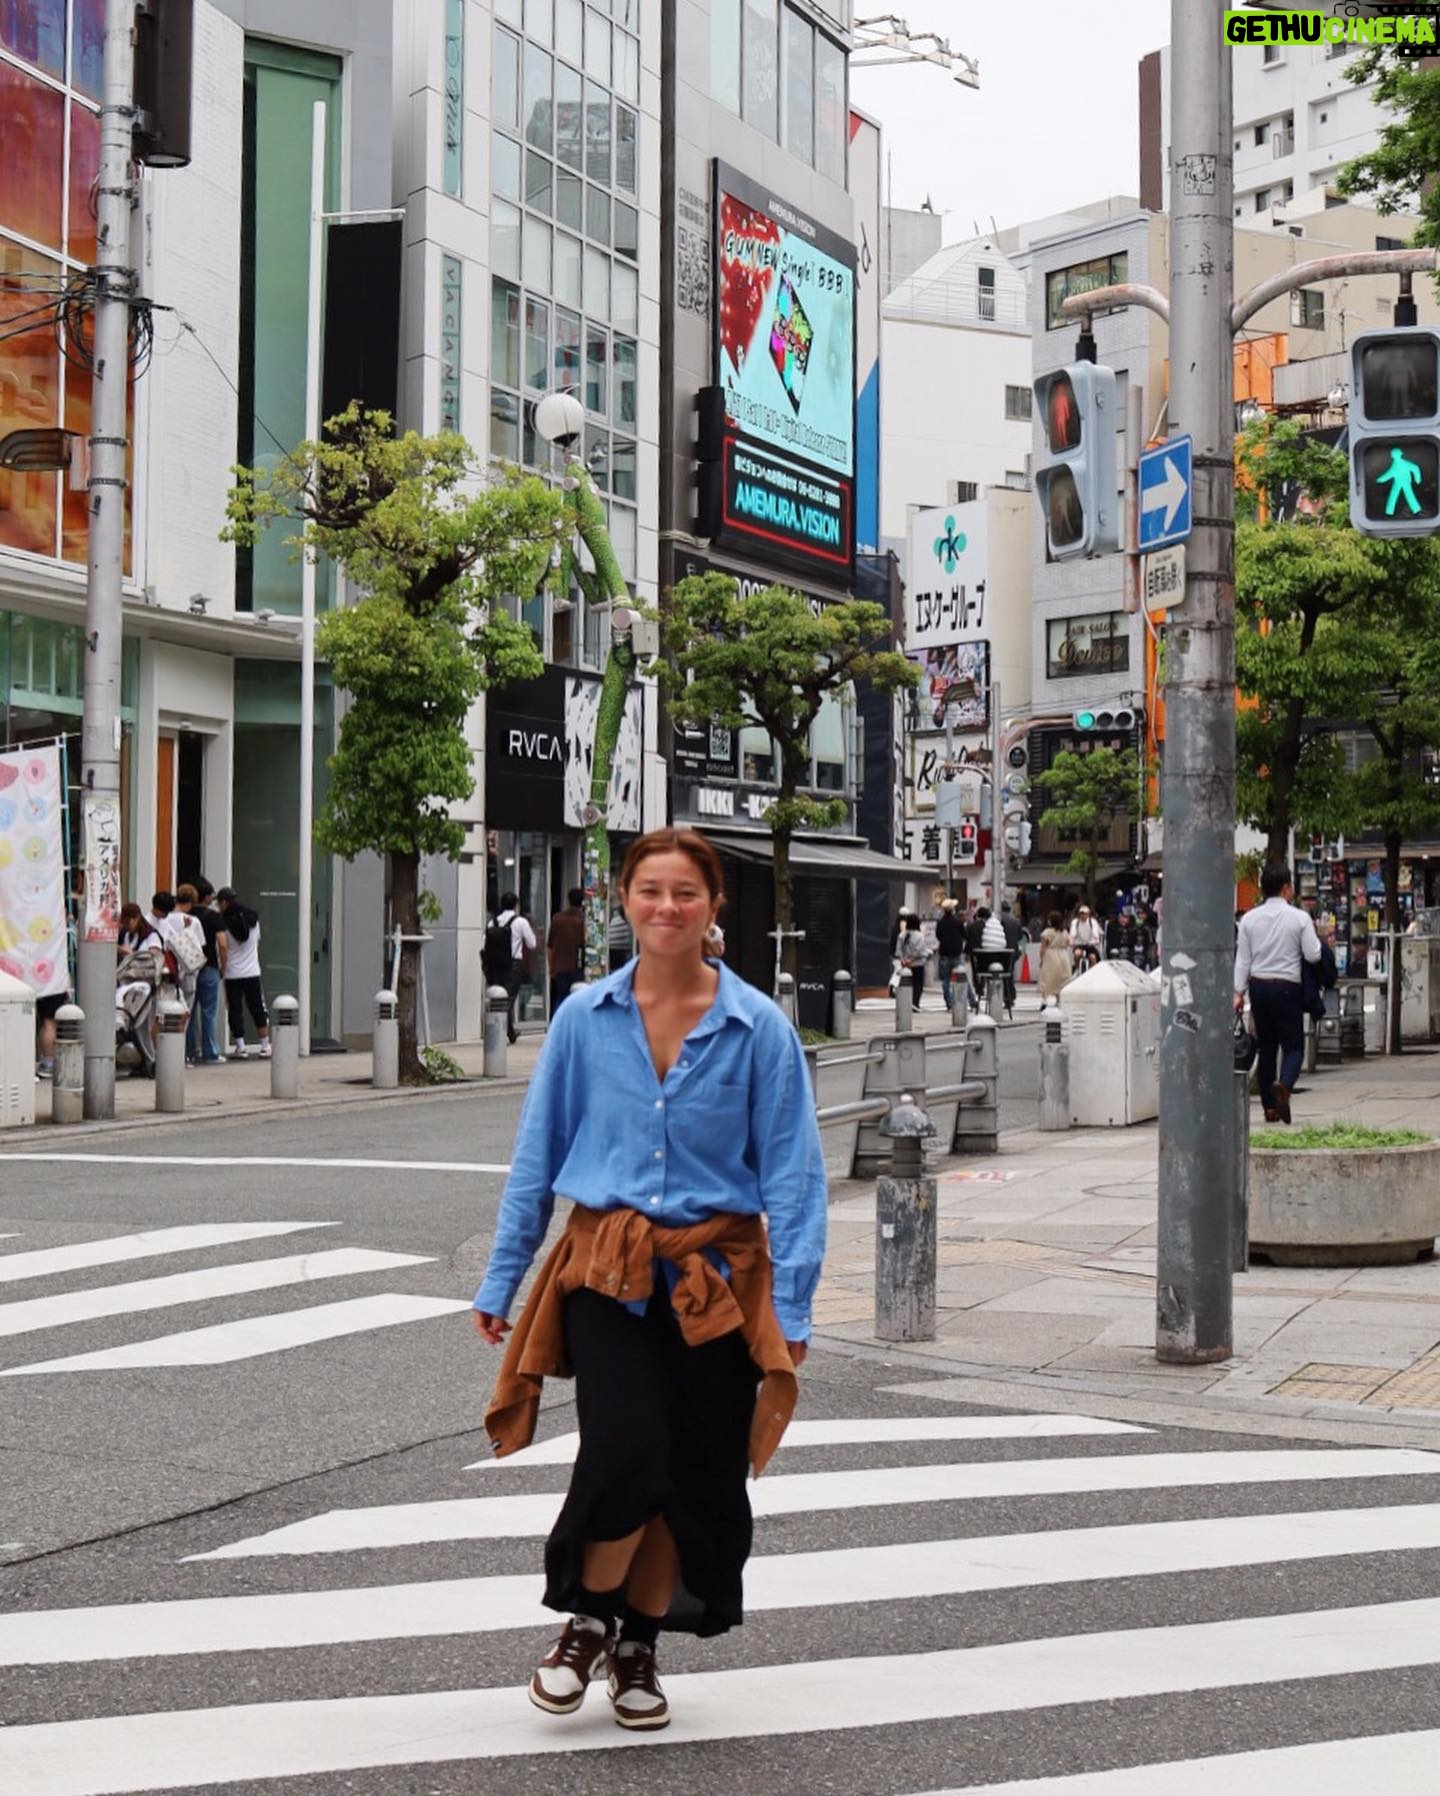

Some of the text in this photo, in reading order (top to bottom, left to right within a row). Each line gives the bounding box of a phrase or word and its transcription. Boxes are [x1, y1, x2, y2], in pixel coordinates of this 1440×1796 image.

[781, 251, 810, 287] Single
[915, 579, 986, 633] エヌケーグループ
[509, 729, 562, 762] RVCA
[698, 787, 734, 816] IKKI
